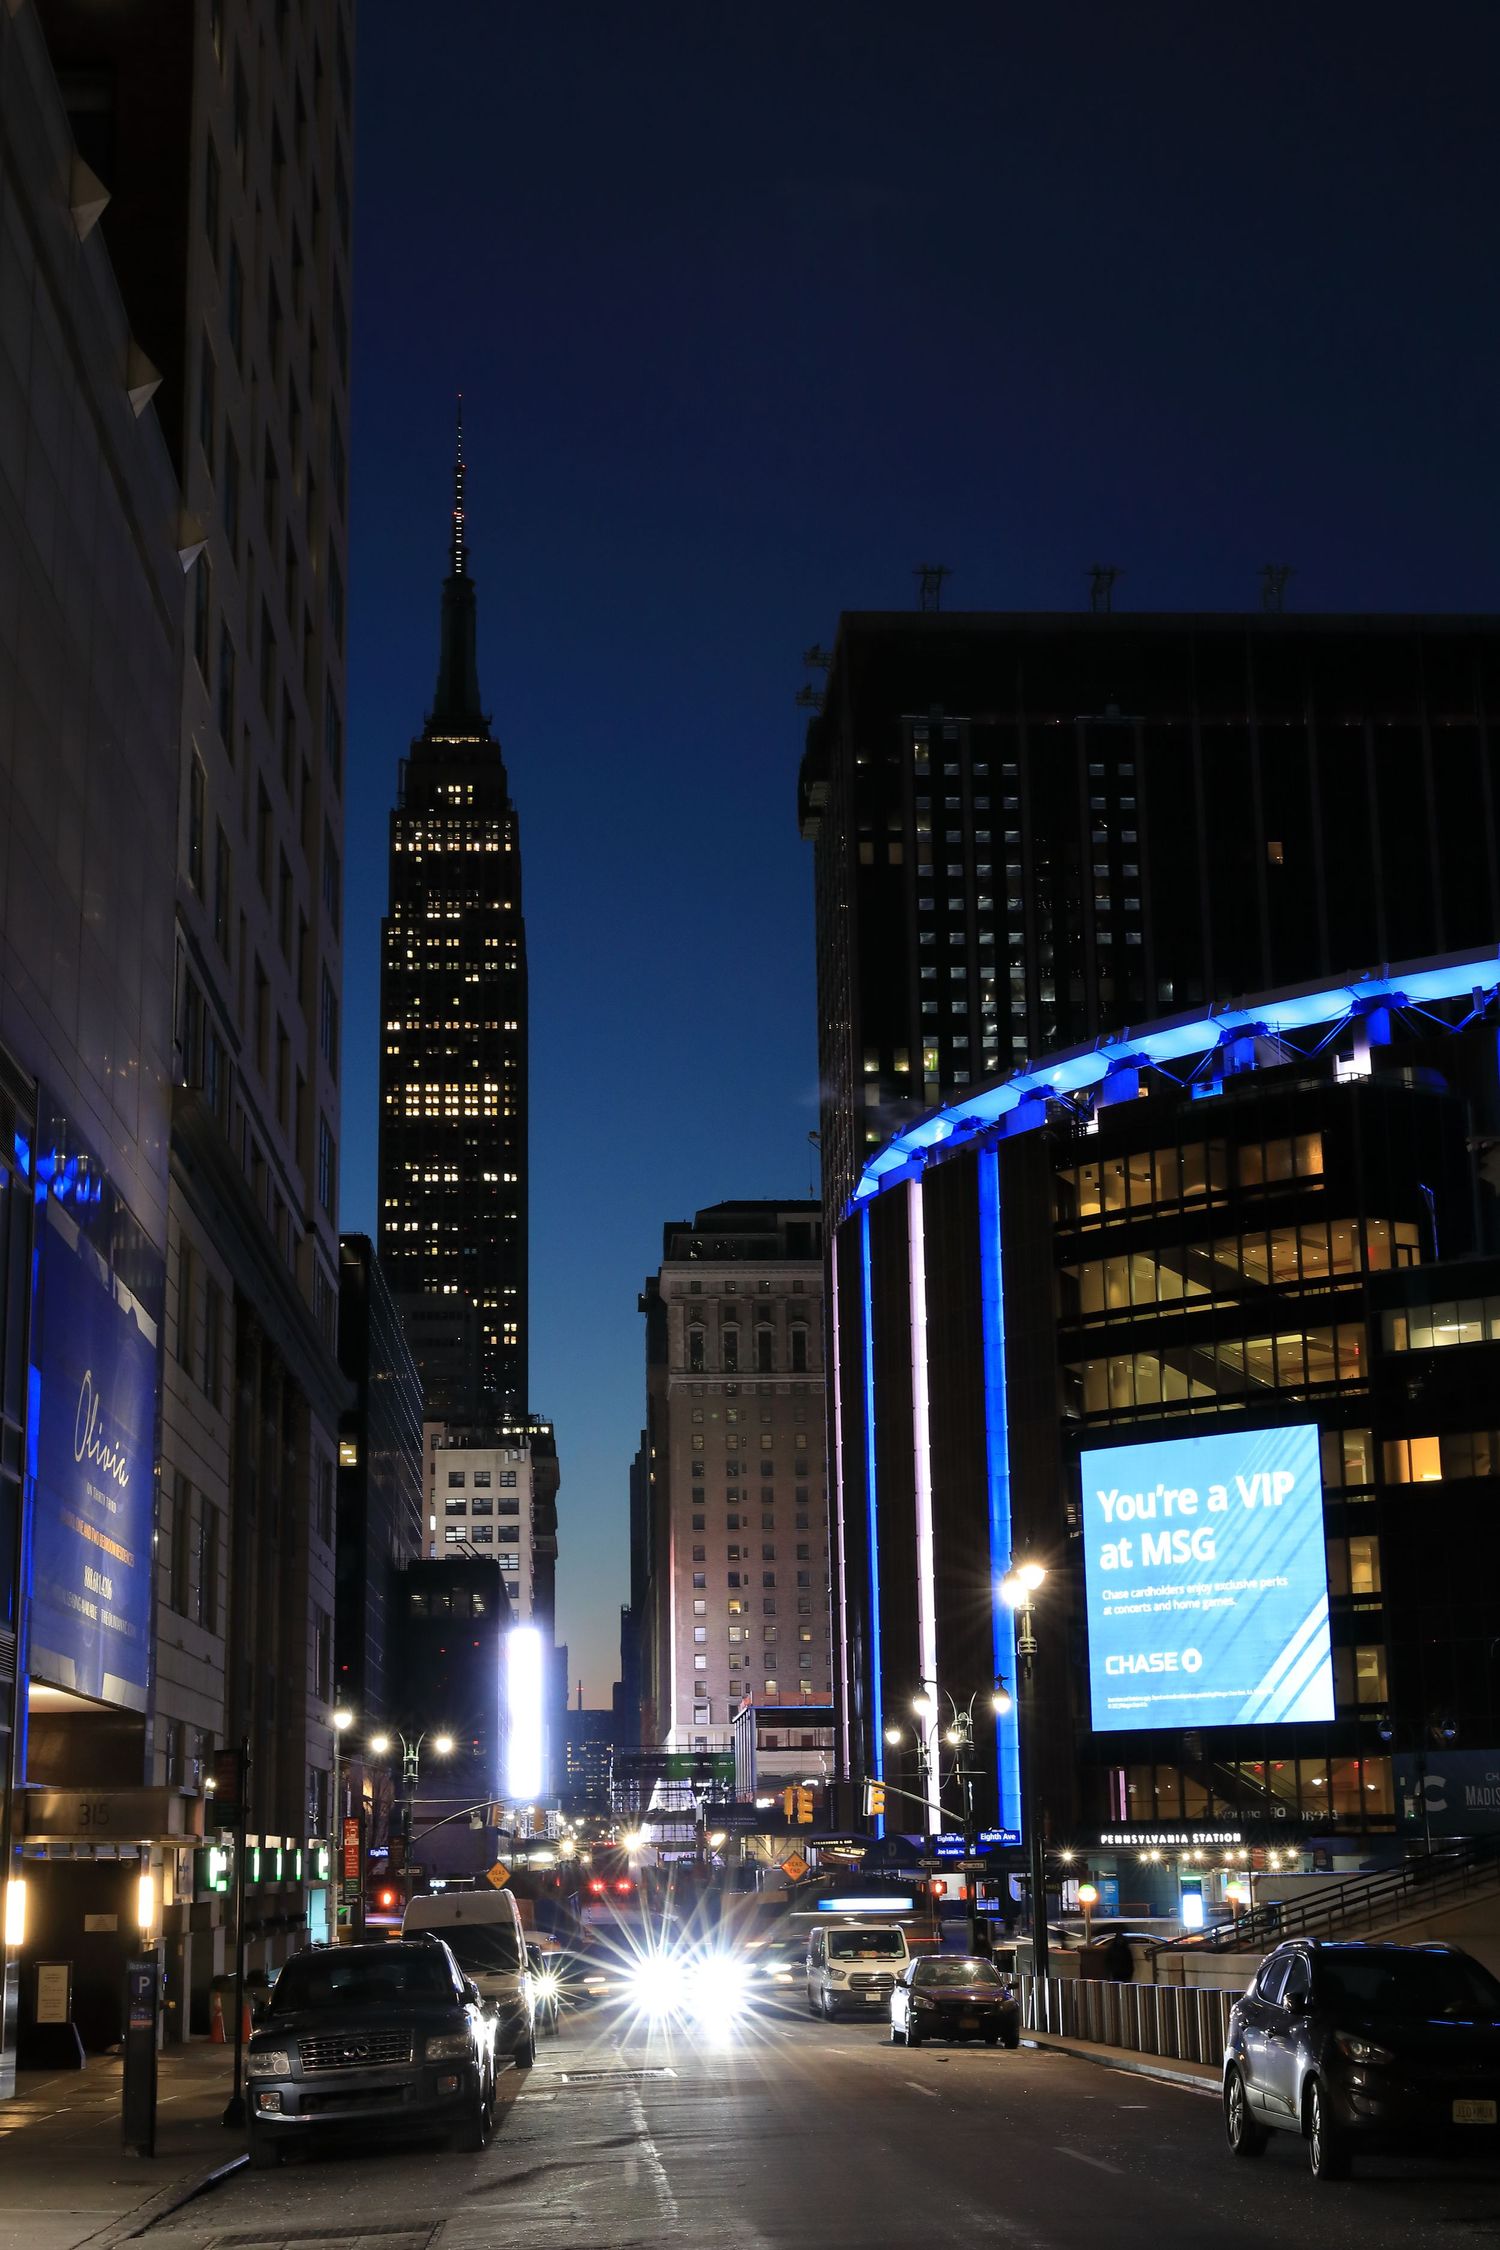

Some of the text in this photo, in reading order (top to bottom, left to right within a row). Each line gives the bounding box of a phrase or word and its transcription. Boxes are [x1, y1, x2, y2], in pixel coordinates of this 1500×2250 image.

[75, 1369, 129, 1488] Olivia
[1096, 1470, 1296, 1523] You're a VIP
[1100, 1526, 1217, 1570] at MSG
[1102, 1576, 1289, 1601] Chase cardholders enjoy exclusive perks
[1103, 1598, 1238, 1616] at concerts and home games.
[1105, 1652, 1179, 1675] CHASE
[79, 1803, 110, 1826] 315
[936, 1835, 952, 1844] Eighth
[980, 1832, 1017, 1842] Eighth Ave
[1100, 1832, 1242, 1844] PENNSYLVANIA STATION
[370, 1849, 389, 1858] Eighth
[139, 1976, 151, 1994] P
